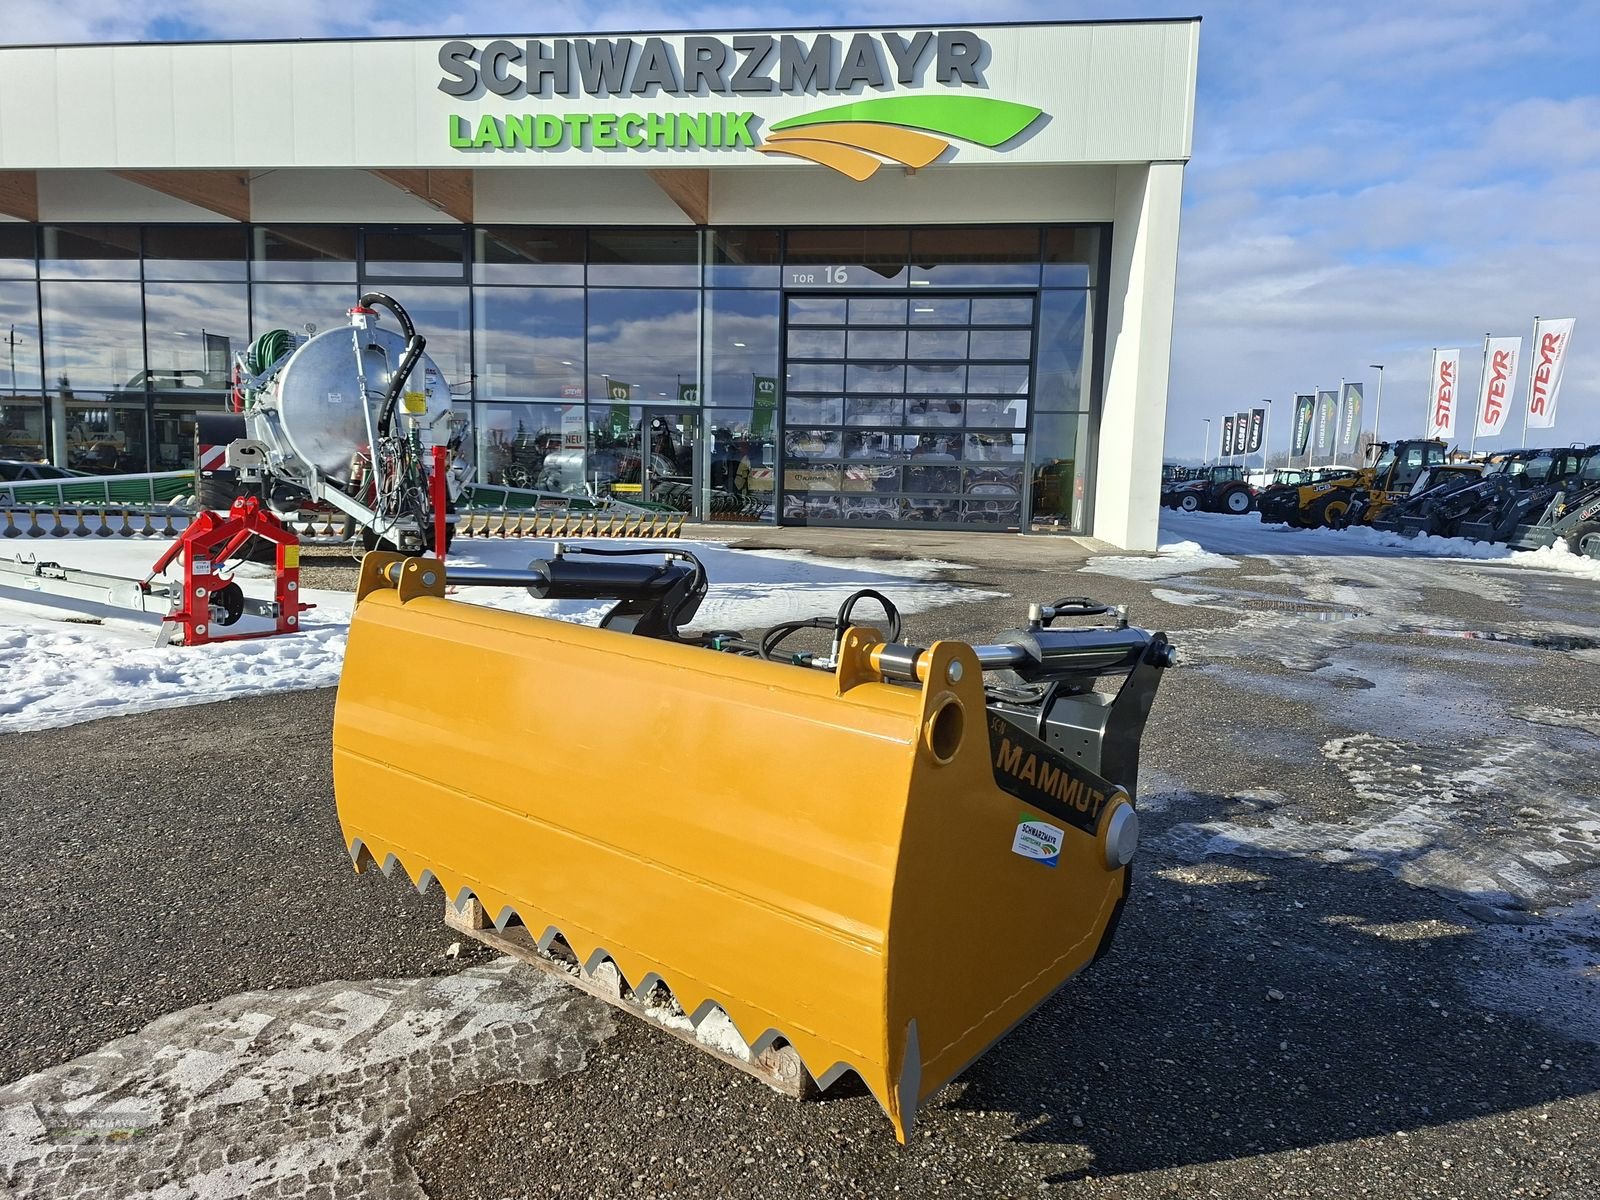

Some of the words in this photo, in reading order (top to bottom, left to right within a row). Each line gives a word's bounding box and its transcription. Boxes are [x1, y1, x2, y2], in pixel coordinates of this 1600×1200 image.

[438, 30, 989, 97] SCHWARZMAYR
[450, 111, 754, 149] LANDTECHNIK
[792, 273, 815, 283] TOR
[824, 265, 848, 284] 16
[1435, 361, 1452, 429] STEYR
[1484, 350, 1510, 426] STEYR
[1531, 333, 1561, 416] STEYR
[565, 434, 582, 444] NEU
[1296, 407, 1306, 449] SCHWARZMAYR
[1318, 404, 1327, 448] SCHWARZMAYR
[1343, 397, 1354, 445] SCHWARZMAYR
[1313, 483, 1332, 492] JCB
[996, 737, 1105, 819] MAMMUT
[1021, 823, 1057, 845] SCHWARZMAYR
